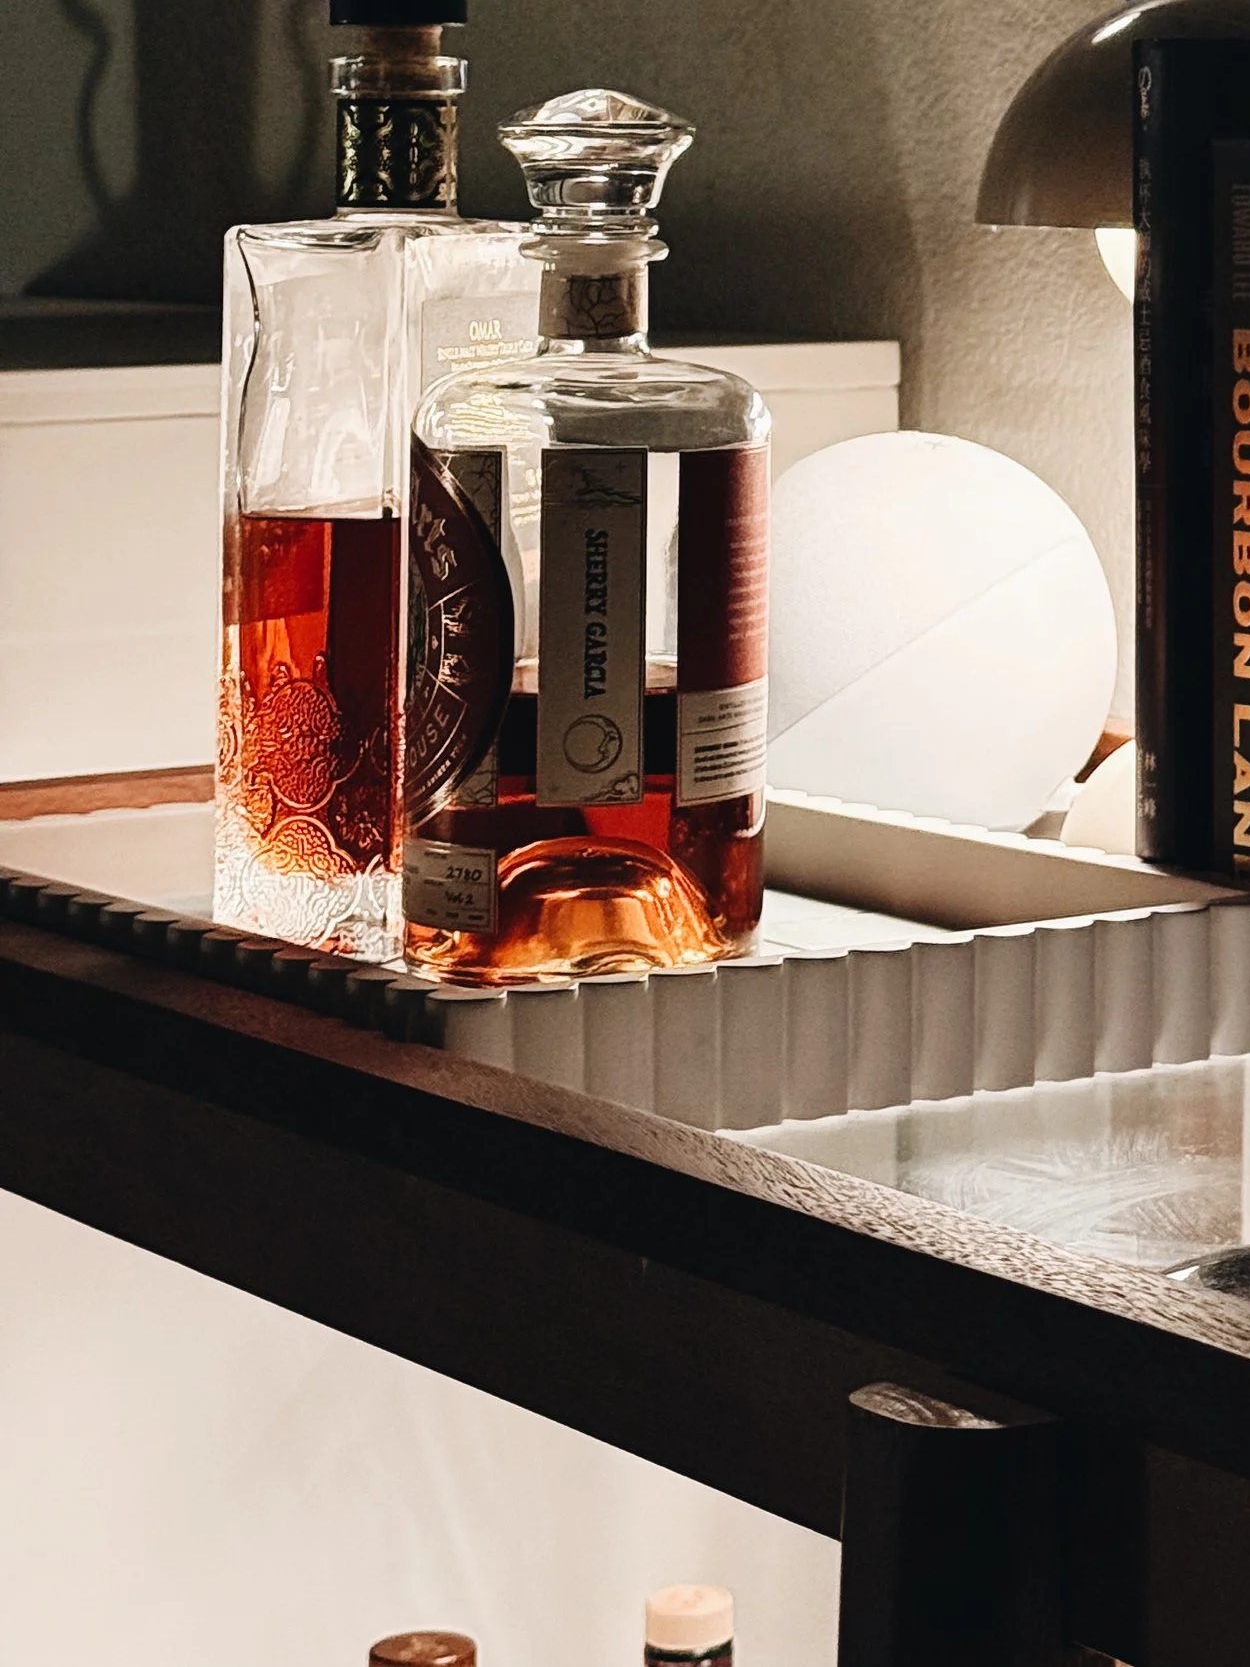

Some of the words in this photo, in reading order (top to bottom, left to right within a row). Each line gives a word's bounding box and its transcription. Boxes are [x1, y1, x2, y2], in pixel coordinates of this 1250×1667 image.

[469, 319, 503, 341] OMAR
[584, 528, 609, 616] SHERRY
[584, 621, 608, 700] GARCIA
[405, 704, 450, 768] OUSE
[446, 865, 482, 882] 2780
